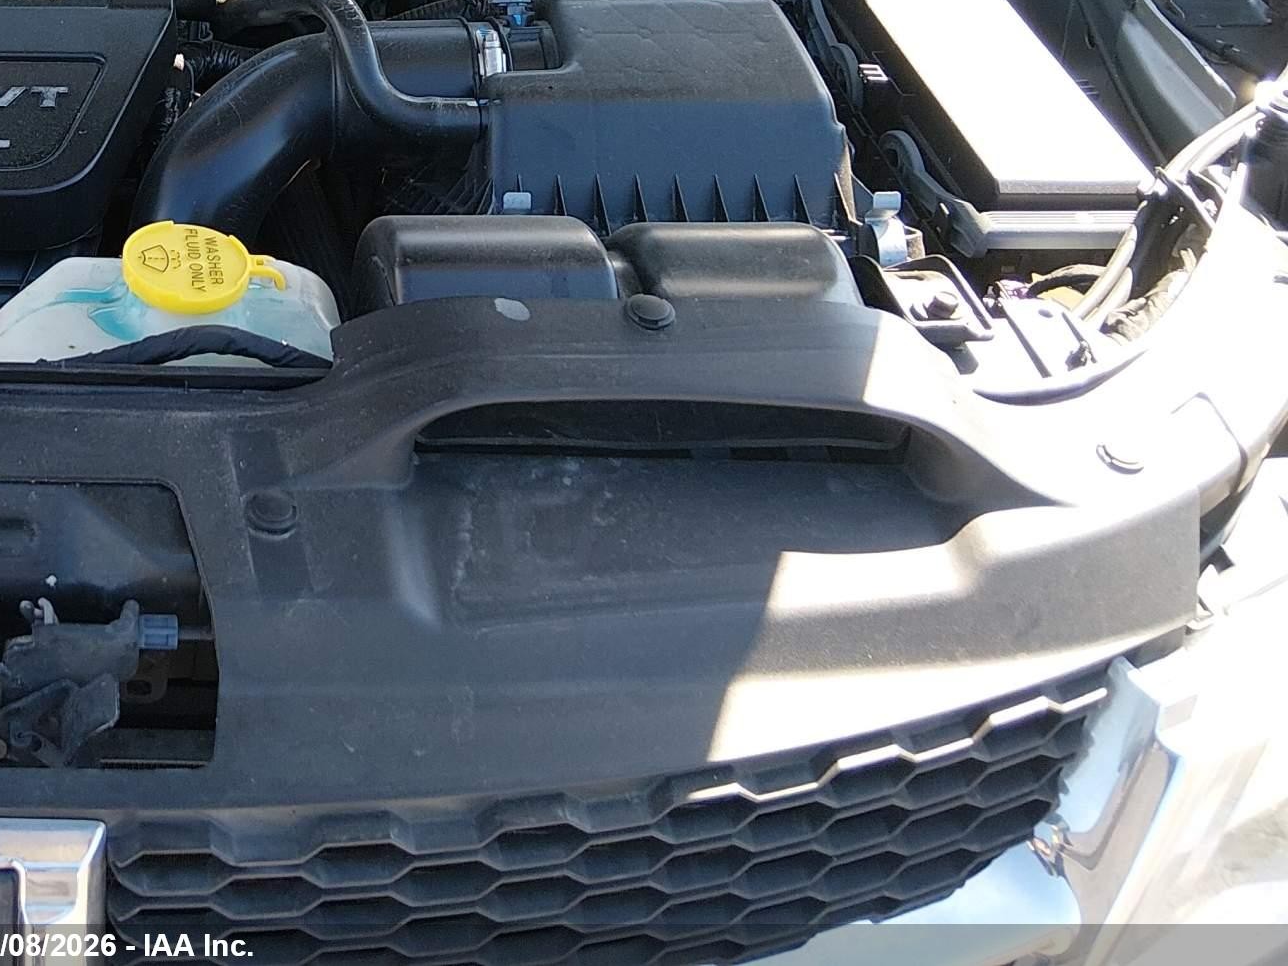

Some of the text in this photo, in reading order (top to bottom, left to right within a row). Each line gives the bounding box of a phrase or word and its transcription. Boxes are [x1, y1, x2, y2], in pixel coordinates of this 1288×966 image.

[184, 228, 207, 293] FLUID ONLY
[204, 236, 224, 286] WASHER
